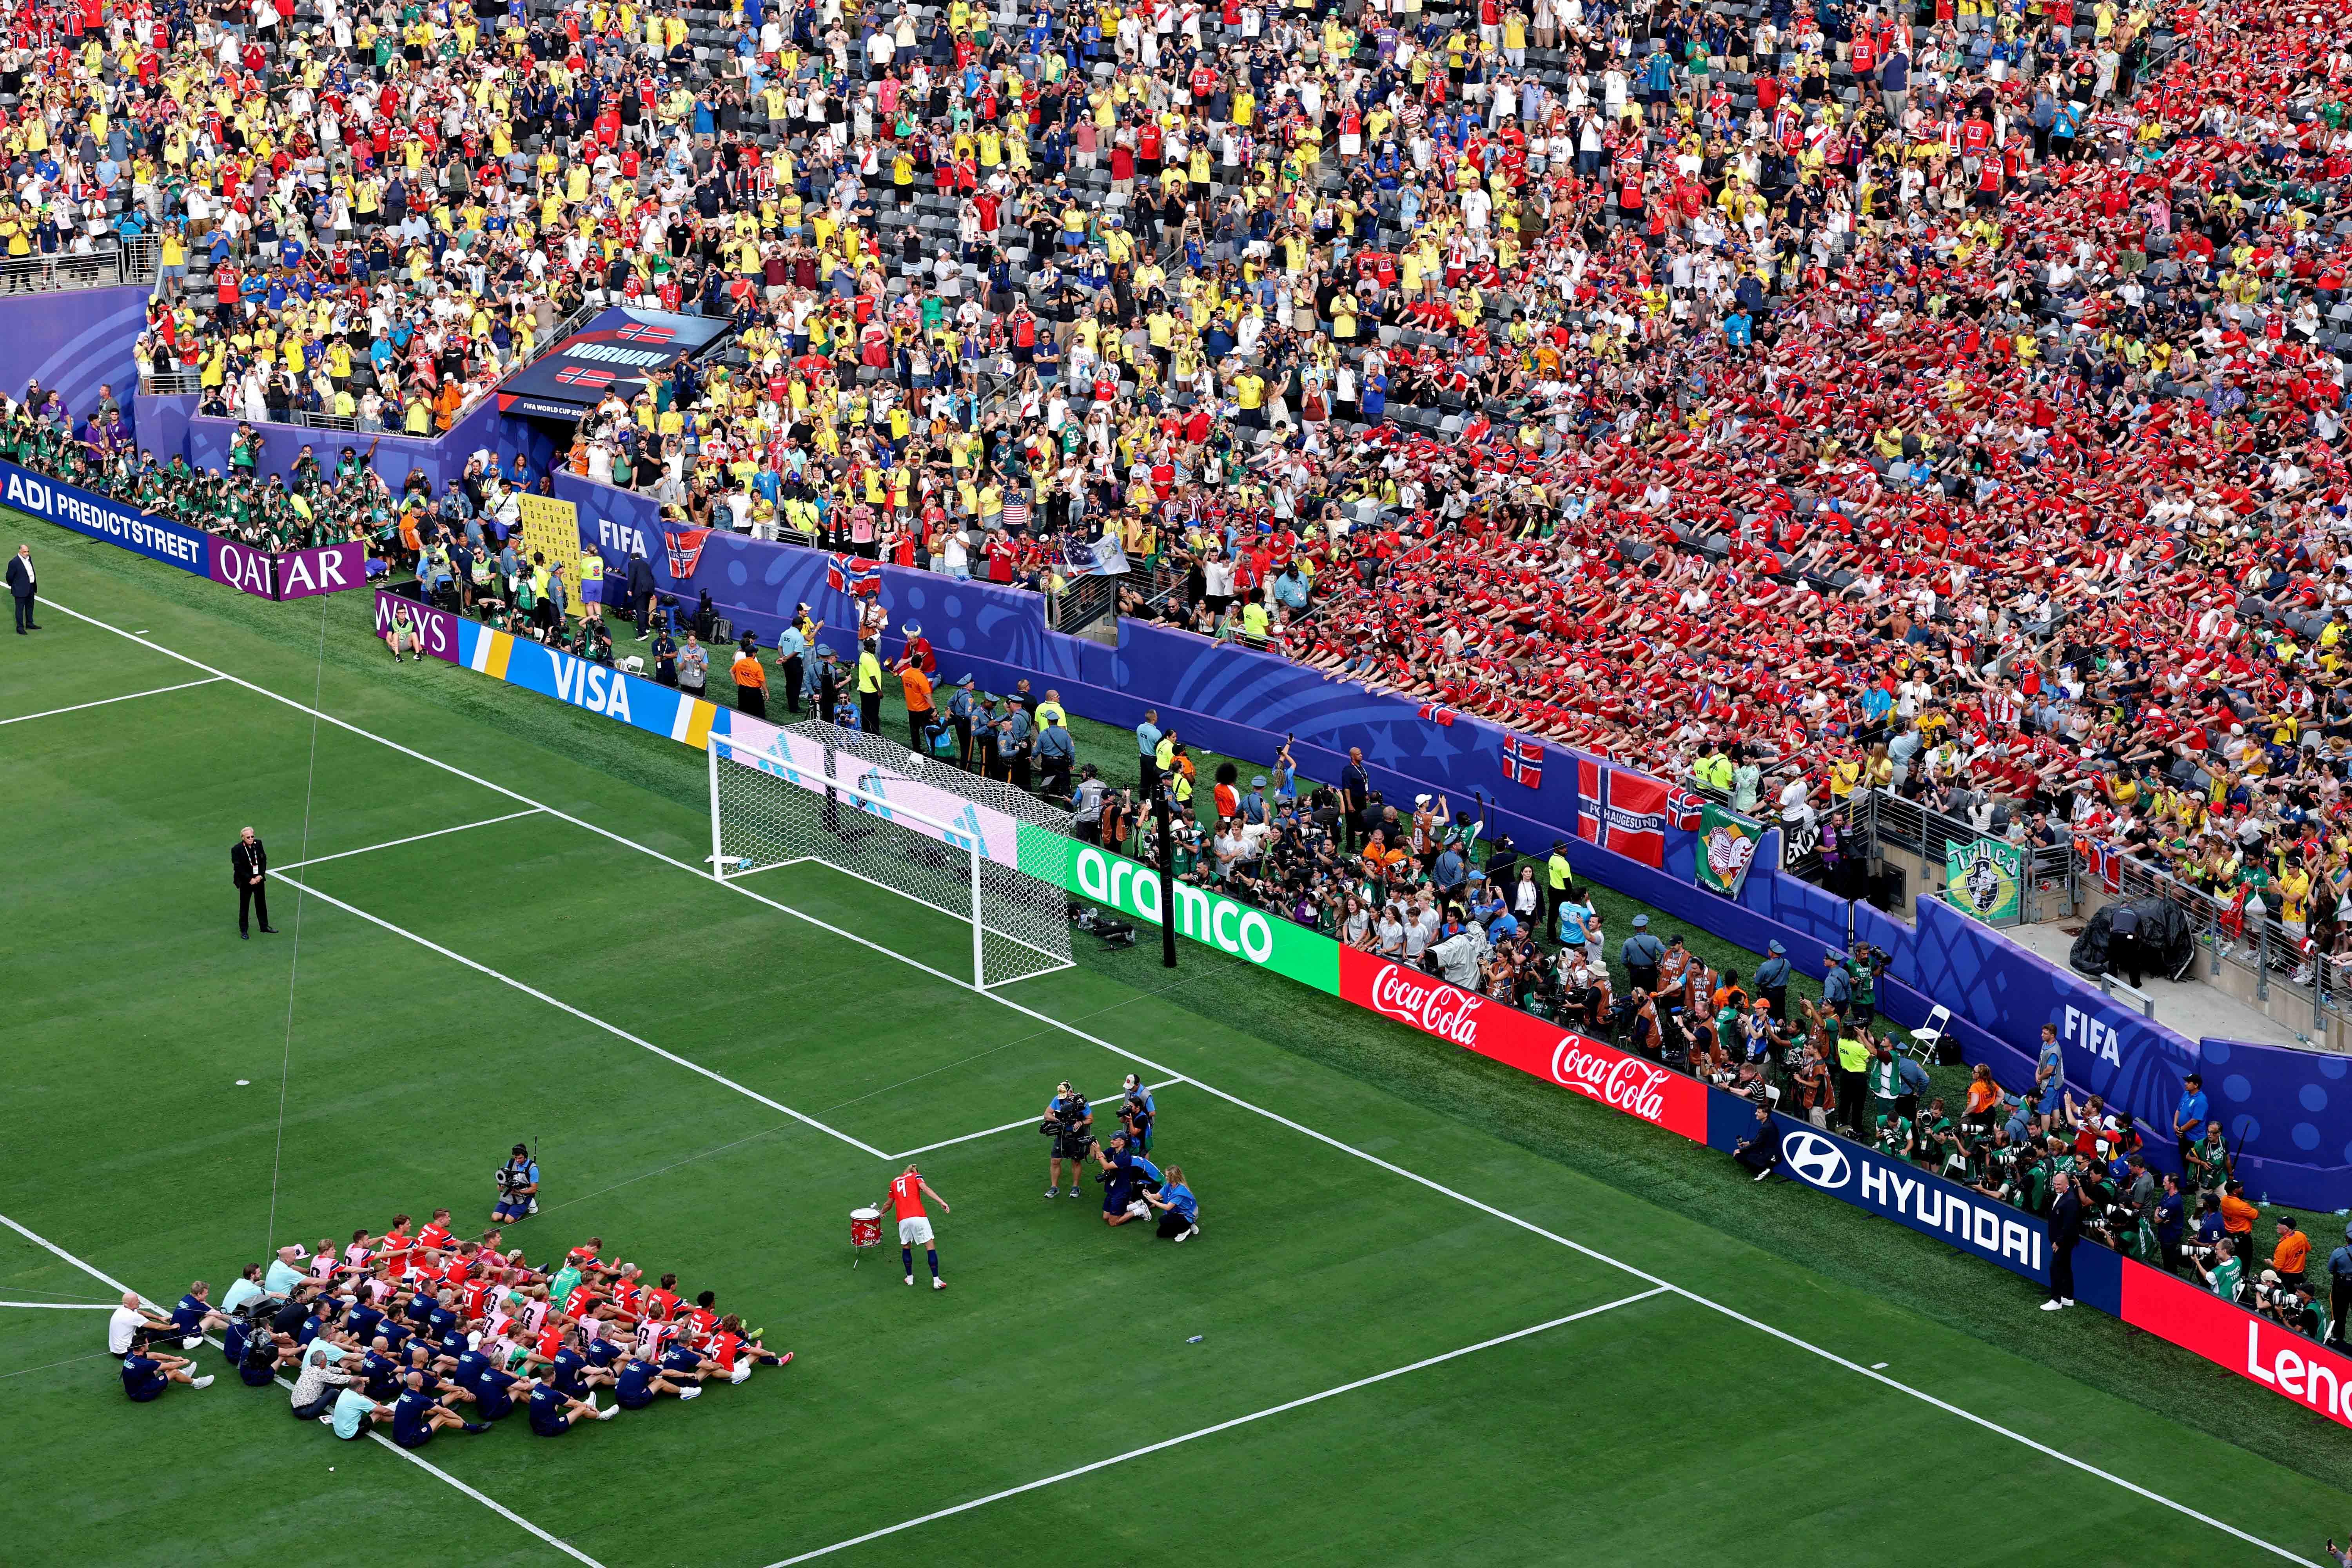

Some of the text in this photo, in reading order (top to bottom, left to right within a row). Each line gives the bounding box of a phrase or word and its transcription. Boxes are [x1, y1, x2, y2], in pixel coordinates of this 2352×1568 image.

[562, 342, 671, 367] NORWAY
[537, 405, 558, 413] WORLD
[1067, 430, 1081, 443] 93
[8, 474, 199, 563] ADI PREDICTSTREET
[599, 519, 648, 559] FIFA
[220, 545, 347, 594] QATAR
[544, 648, 631, 722] VISA
[1590, 803, 1600, 817] FK
[1603, 809, 1658, 829] HAUGESUND
[1077, 848, 1272, 963] aramco
[1372, 964, 1483, 1045] Coca-Cola
[2065, 1004, 2120, 1068] FIFA
[1552, 1035, 1670, 1120] Coca-Cola
[2060, 1156, 2073, 1169] PHOTO
[897, 1179, 907, 1198] 9
[1862, 1160, 2040, 1270] HYUNDAI
[417, 1231, 428, 1245] 3
[553, 1274, 562, 1291] 1
[2225, 1266, 2240, 1277] PHOTO
[565, 1294, 579, 1316] 17
[613, 1289, 624, 1309] 16
[711, 1343, 723, 1361] 6
